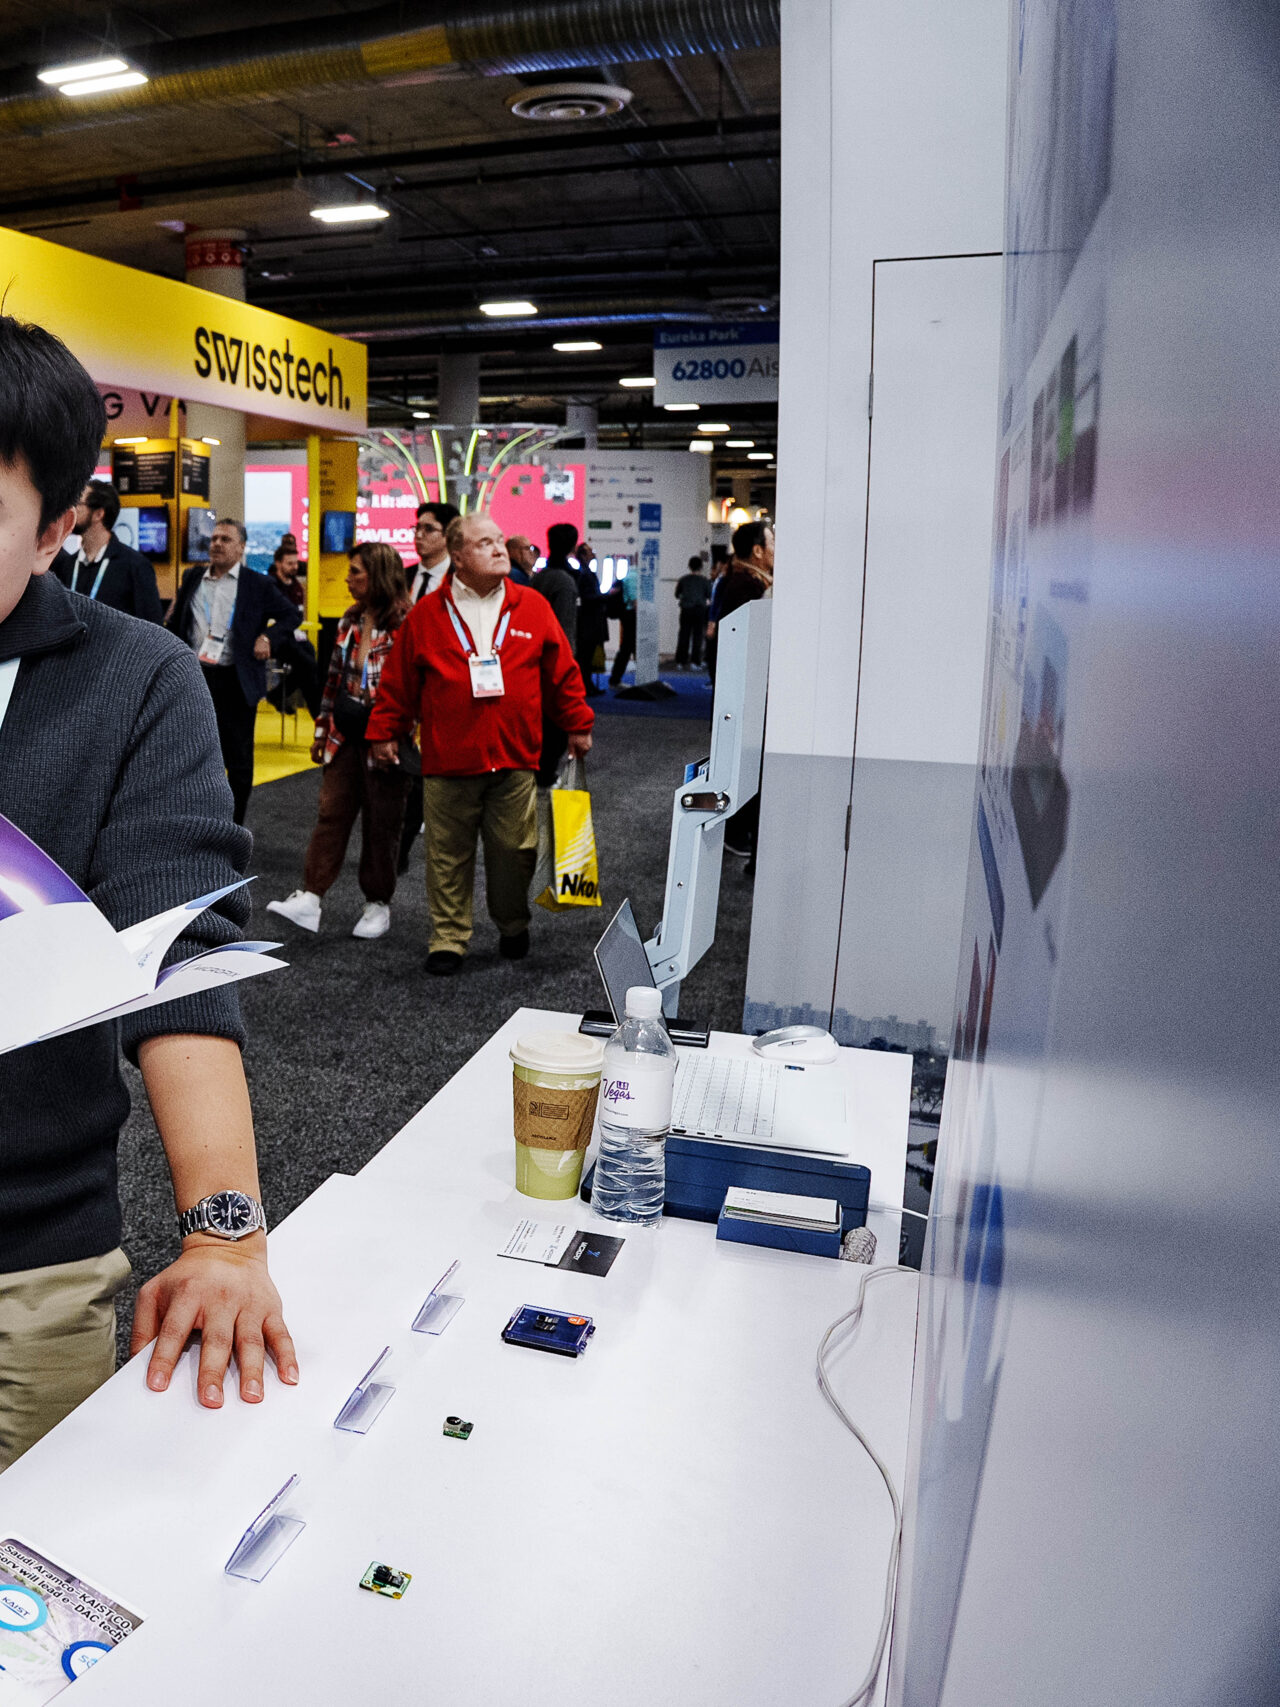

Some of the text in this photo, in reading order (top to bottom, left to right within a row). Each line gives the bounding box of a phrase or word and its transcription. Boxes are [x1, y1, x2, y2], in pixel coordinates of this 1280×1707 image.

[660, 327, 739, 344] Eureka Park
[672, 358, 746, 381] 62800
[603, 1078, 635, 1104] Vegas
[4, 1545, 36, 1567] Saudi
[1, 1596, 31, 1617] KAIST
[20, 1567, 39, 1584] will
[37, 1577, 63, 1599] lead
[98, 1618, 124, 1642] tech
